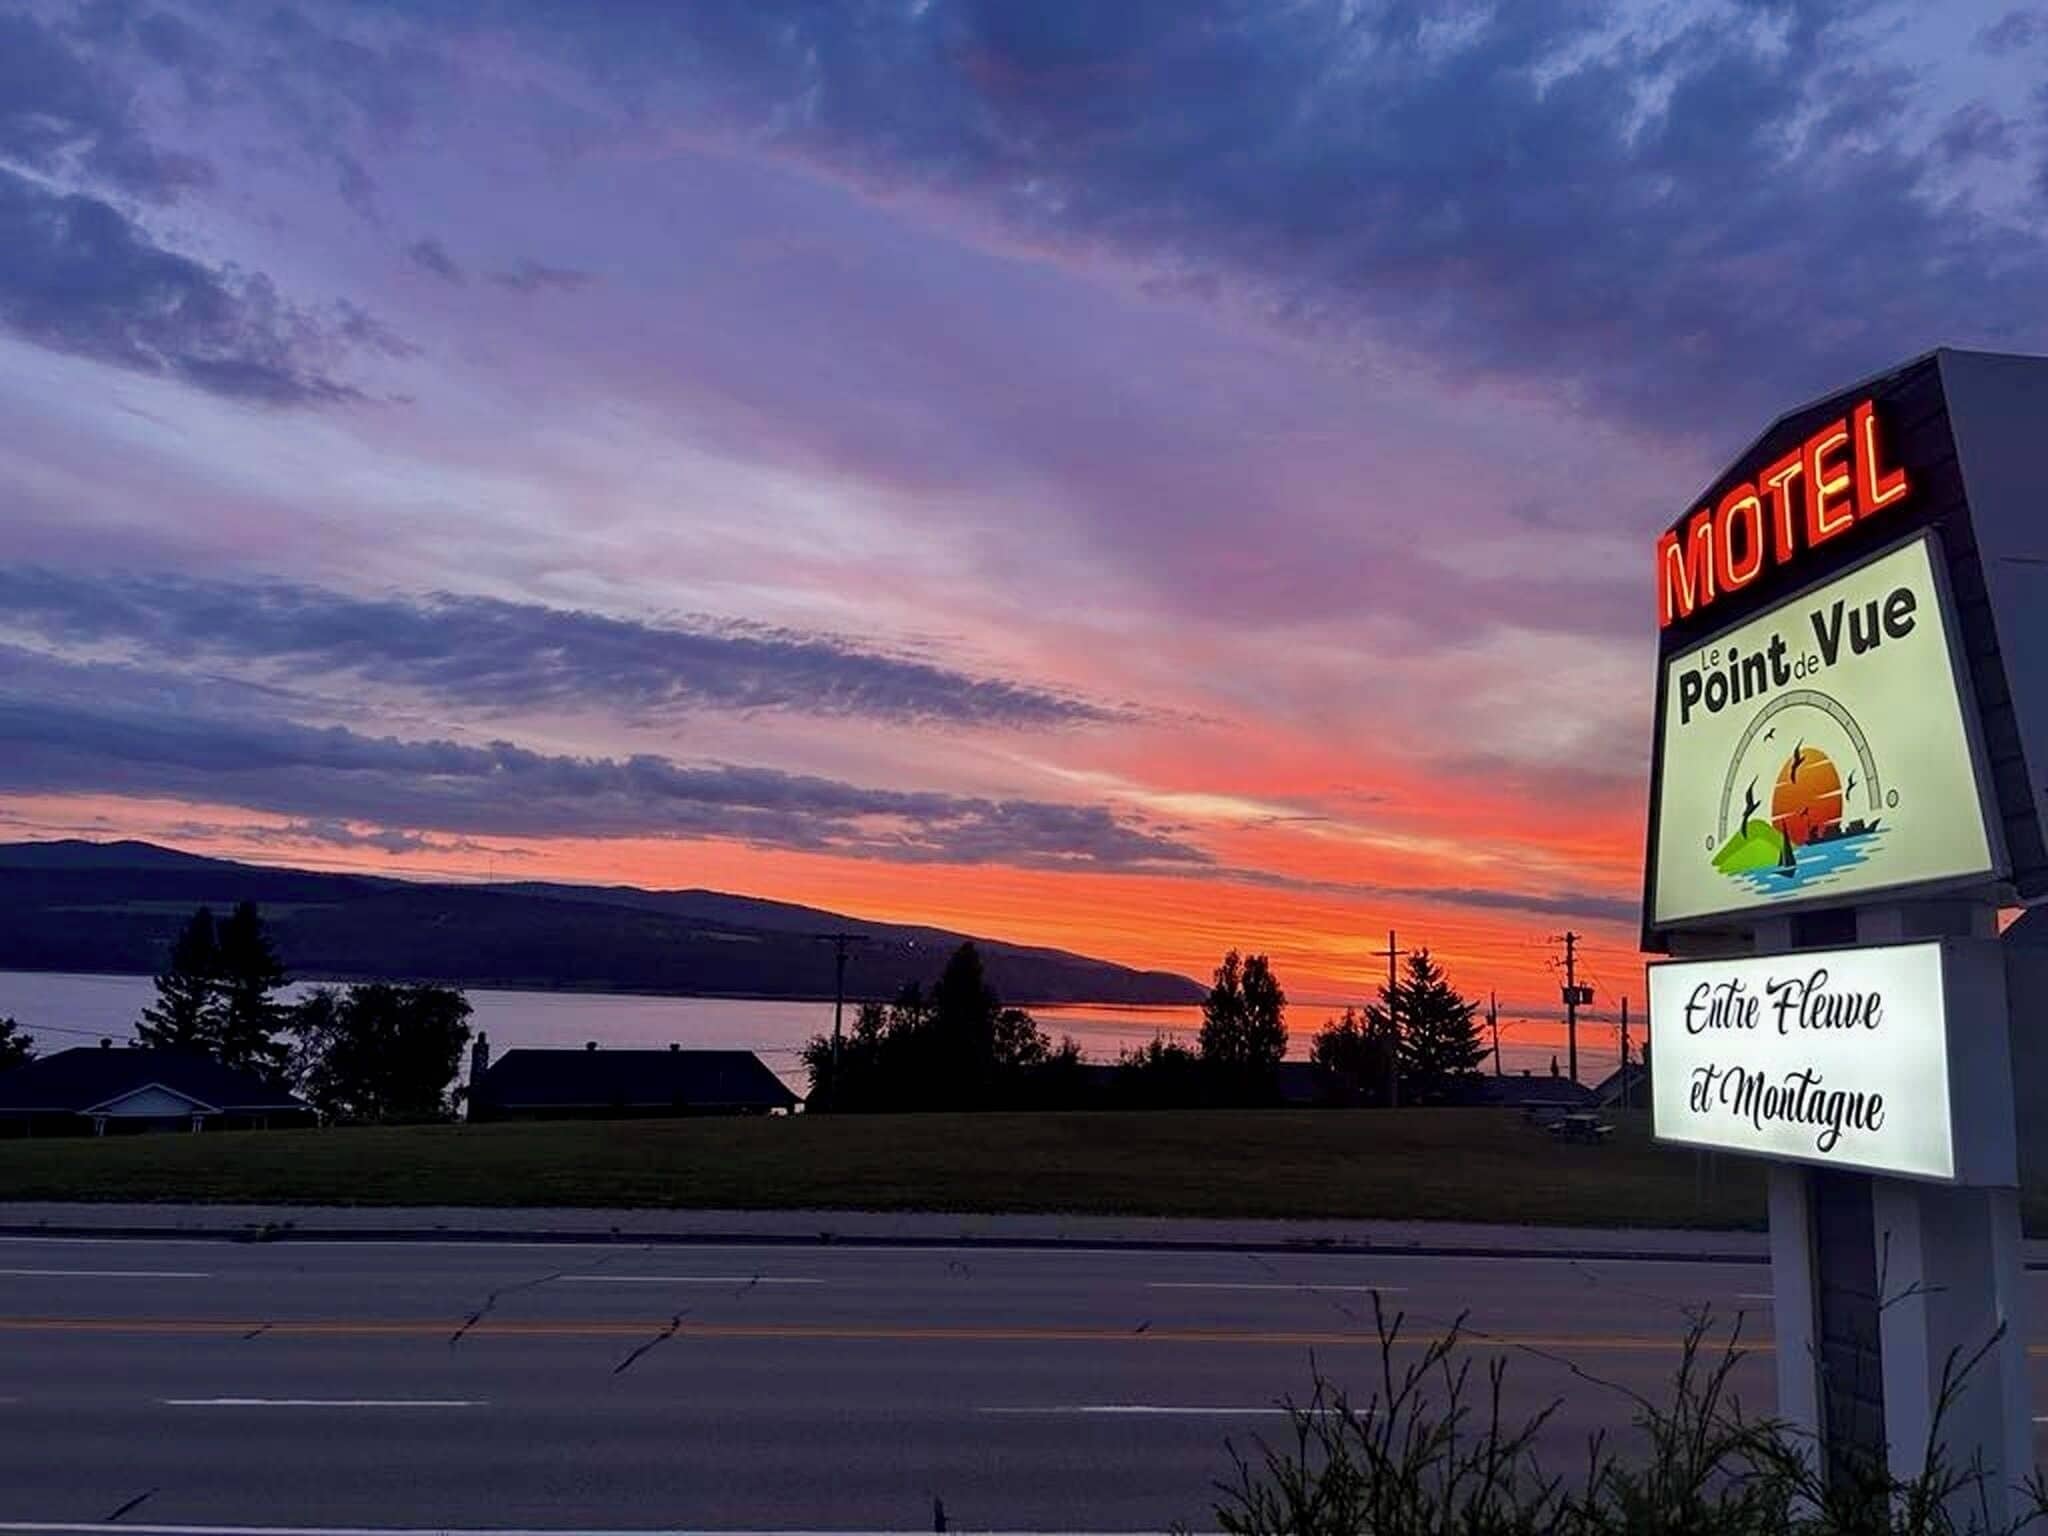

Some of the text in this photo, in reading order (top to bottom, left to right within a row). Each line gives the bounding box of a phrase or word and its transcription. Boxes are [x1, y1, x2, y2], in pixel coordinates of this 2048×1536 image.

[1657, 400, 1908, 627] MOTEL
[1679, 587, 1917, 725] Point de Vue
[1701, 649, 1720, 671] Le
[1684, 968, 1883, 1035] Entre Fleuve
[1690, 1064, 1885, 1152] et Montagne
